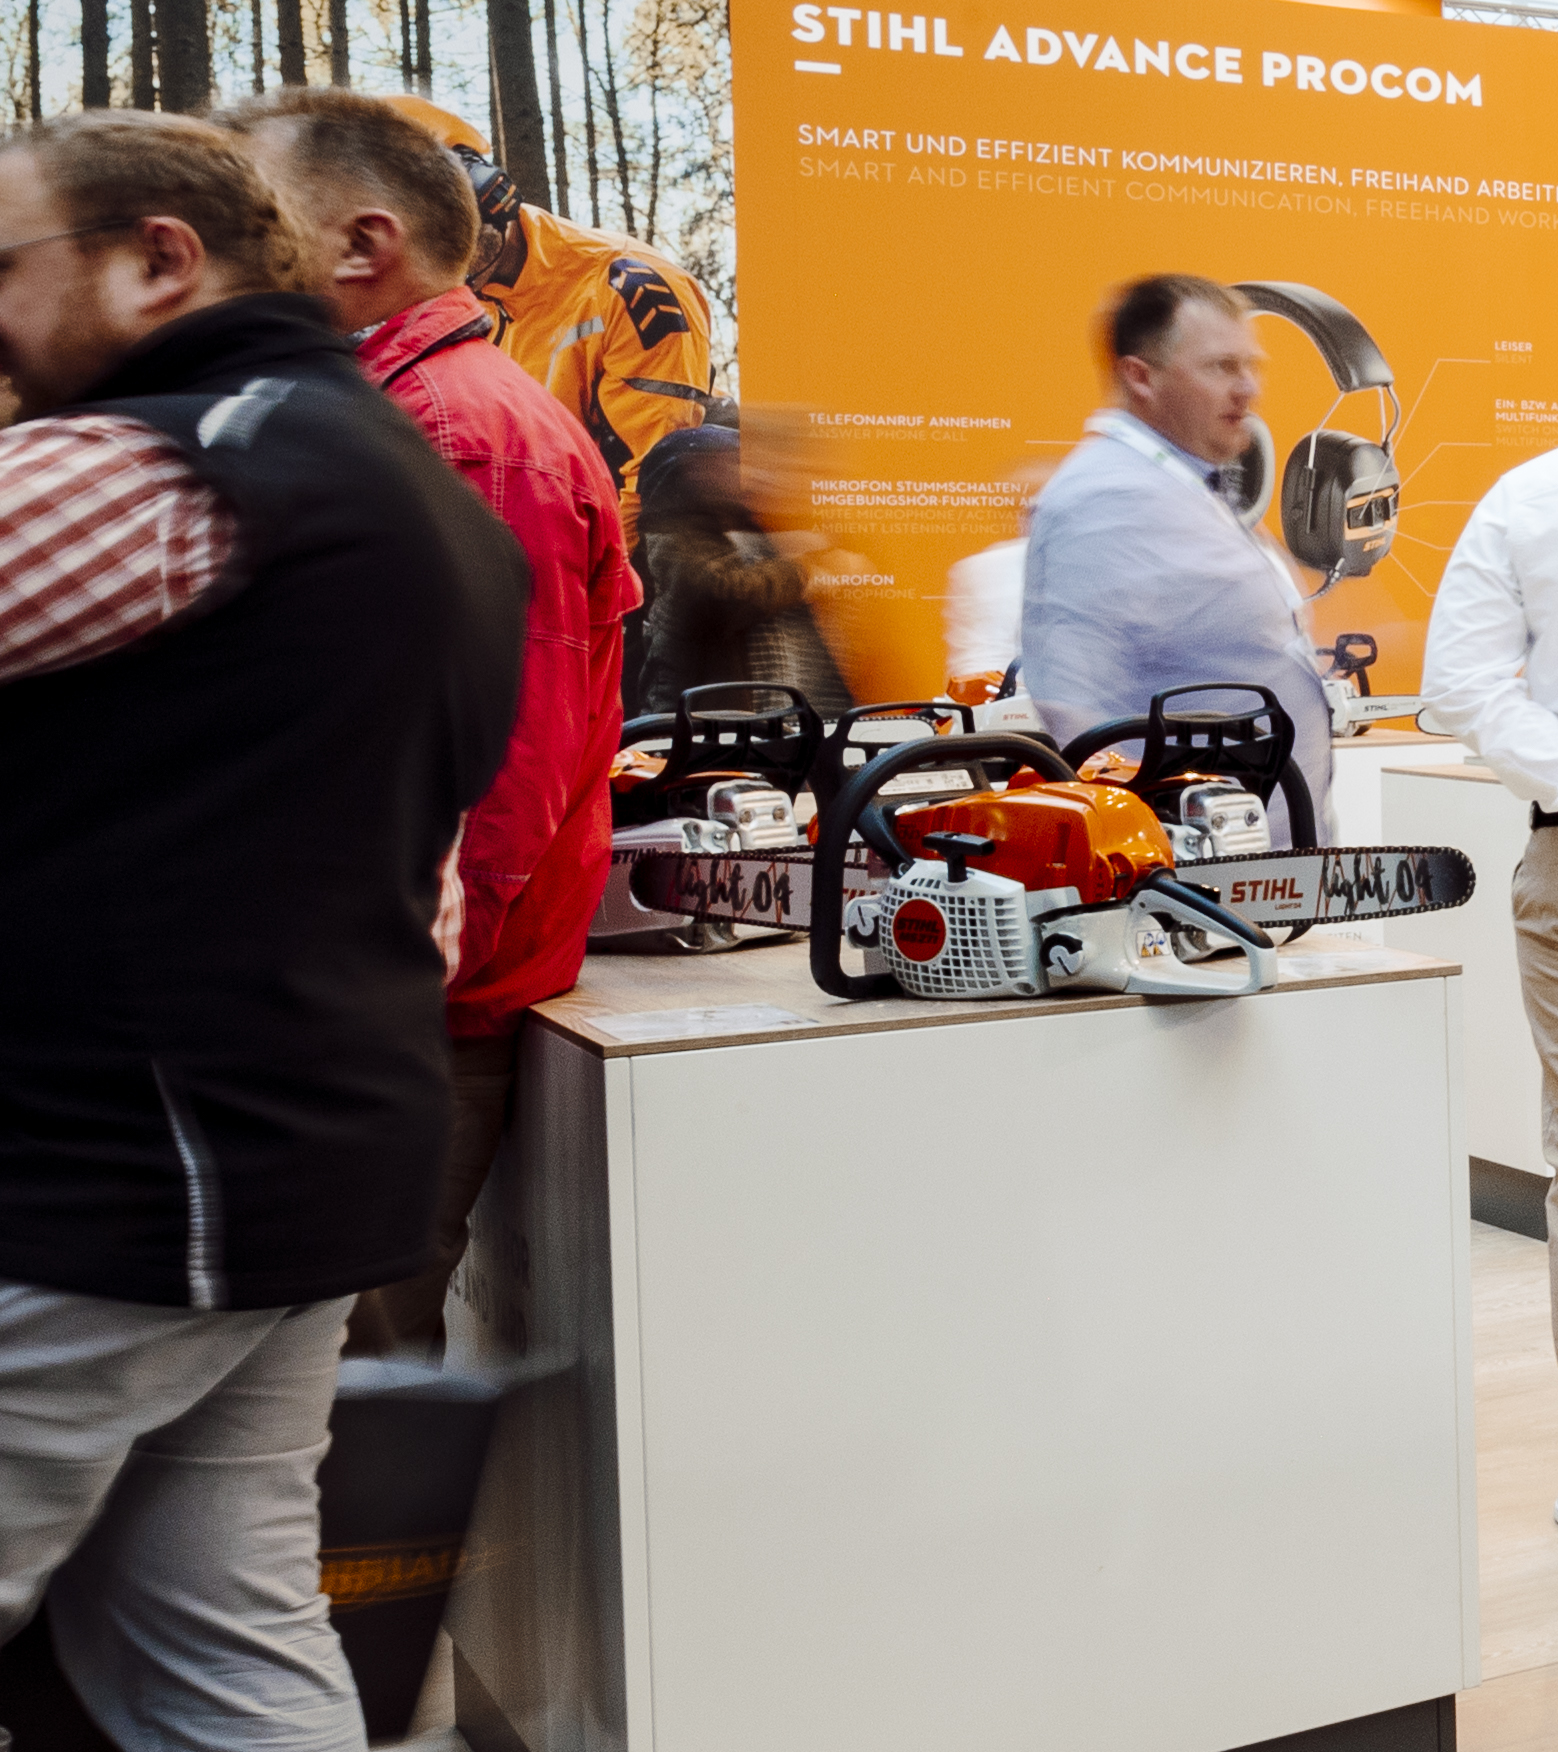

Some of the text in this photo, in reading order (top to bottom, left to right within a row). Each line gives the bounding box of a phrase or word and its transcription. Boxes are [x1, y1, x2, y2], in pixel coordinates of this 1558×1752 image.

[791, 3, 1483, 107] STIHL ADVANCE PROCOM
[798, 123, 896, 151] SMART
[906, 133, 967, 157] UND
[976, 138, 1114, 168] EFFIZIENT
[1121, 149, 1344, 189] KOMMUNIZIEREN,
[1351, 168, 1470, 196] FREIHAND
[799, 156, 897, 183] SMART
[907, 166, 967, 189] AND
[977, 170, 1117, 199] EFFICIENT
[1366, 198, 1490, 225] FREEHAND
[1494, 340, 1533, 353] LEISER
[809, 412, 1012, 430] TELEFONANRUF ANNEHMEN
[811, 479, 892, 493] MIKROFON
[813, 573, 895, 587] MIKROFON
[1231, 877, 1304, 904] STIHL
[896, 916, 941, 934] STIHL
